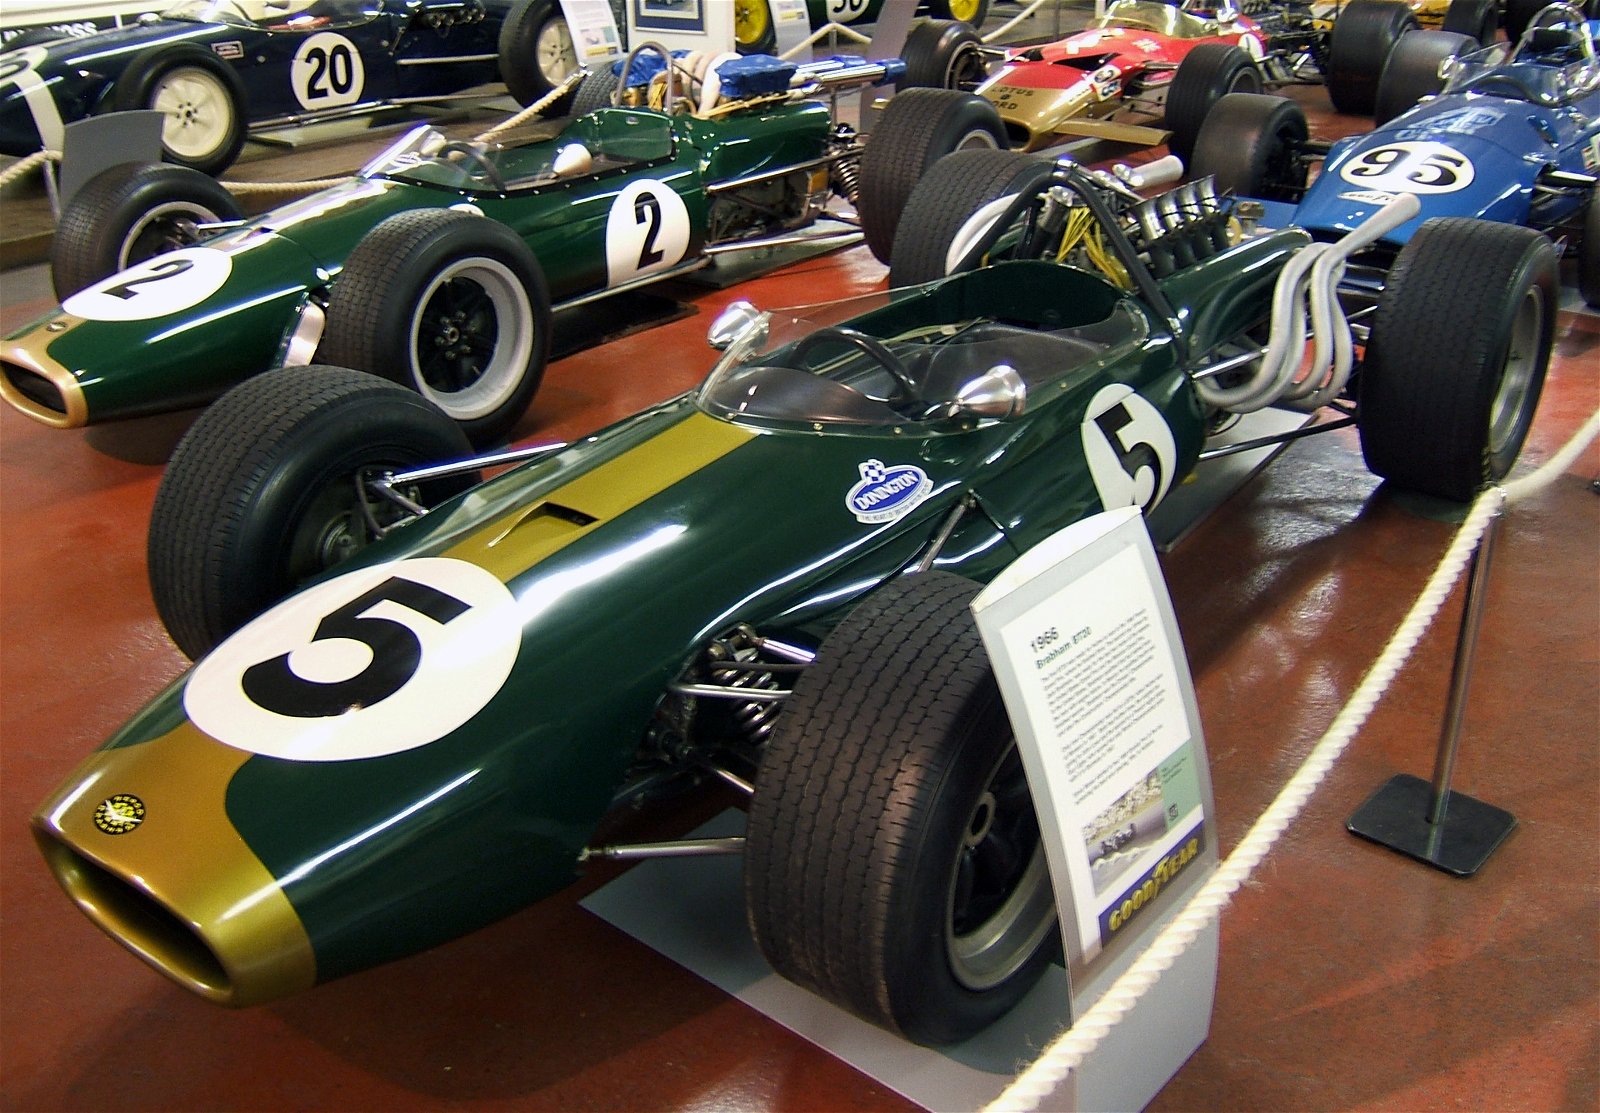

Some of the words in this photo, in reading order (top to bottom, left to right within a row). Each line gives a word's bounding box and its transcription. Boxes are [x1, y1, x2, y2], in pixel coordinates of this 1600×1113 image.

[305, 44, 352, 99] 20
[992, 101, 1018, 110] ORD
[1350, 149, 1465, 186] 95
[634, 192, 665, 270] 2
[100, 259, 195, 300] 2
[1093, 401, 1162, 517] 5
[854, 471, 919, 510] DONINGTON
[242, 576, 473, 718] 5
[1030, 626, 1059, 653] 1966
[1035, 641, 1072, 669] Brabham
[1109, 838, 1198, 931] GOODYEAR
